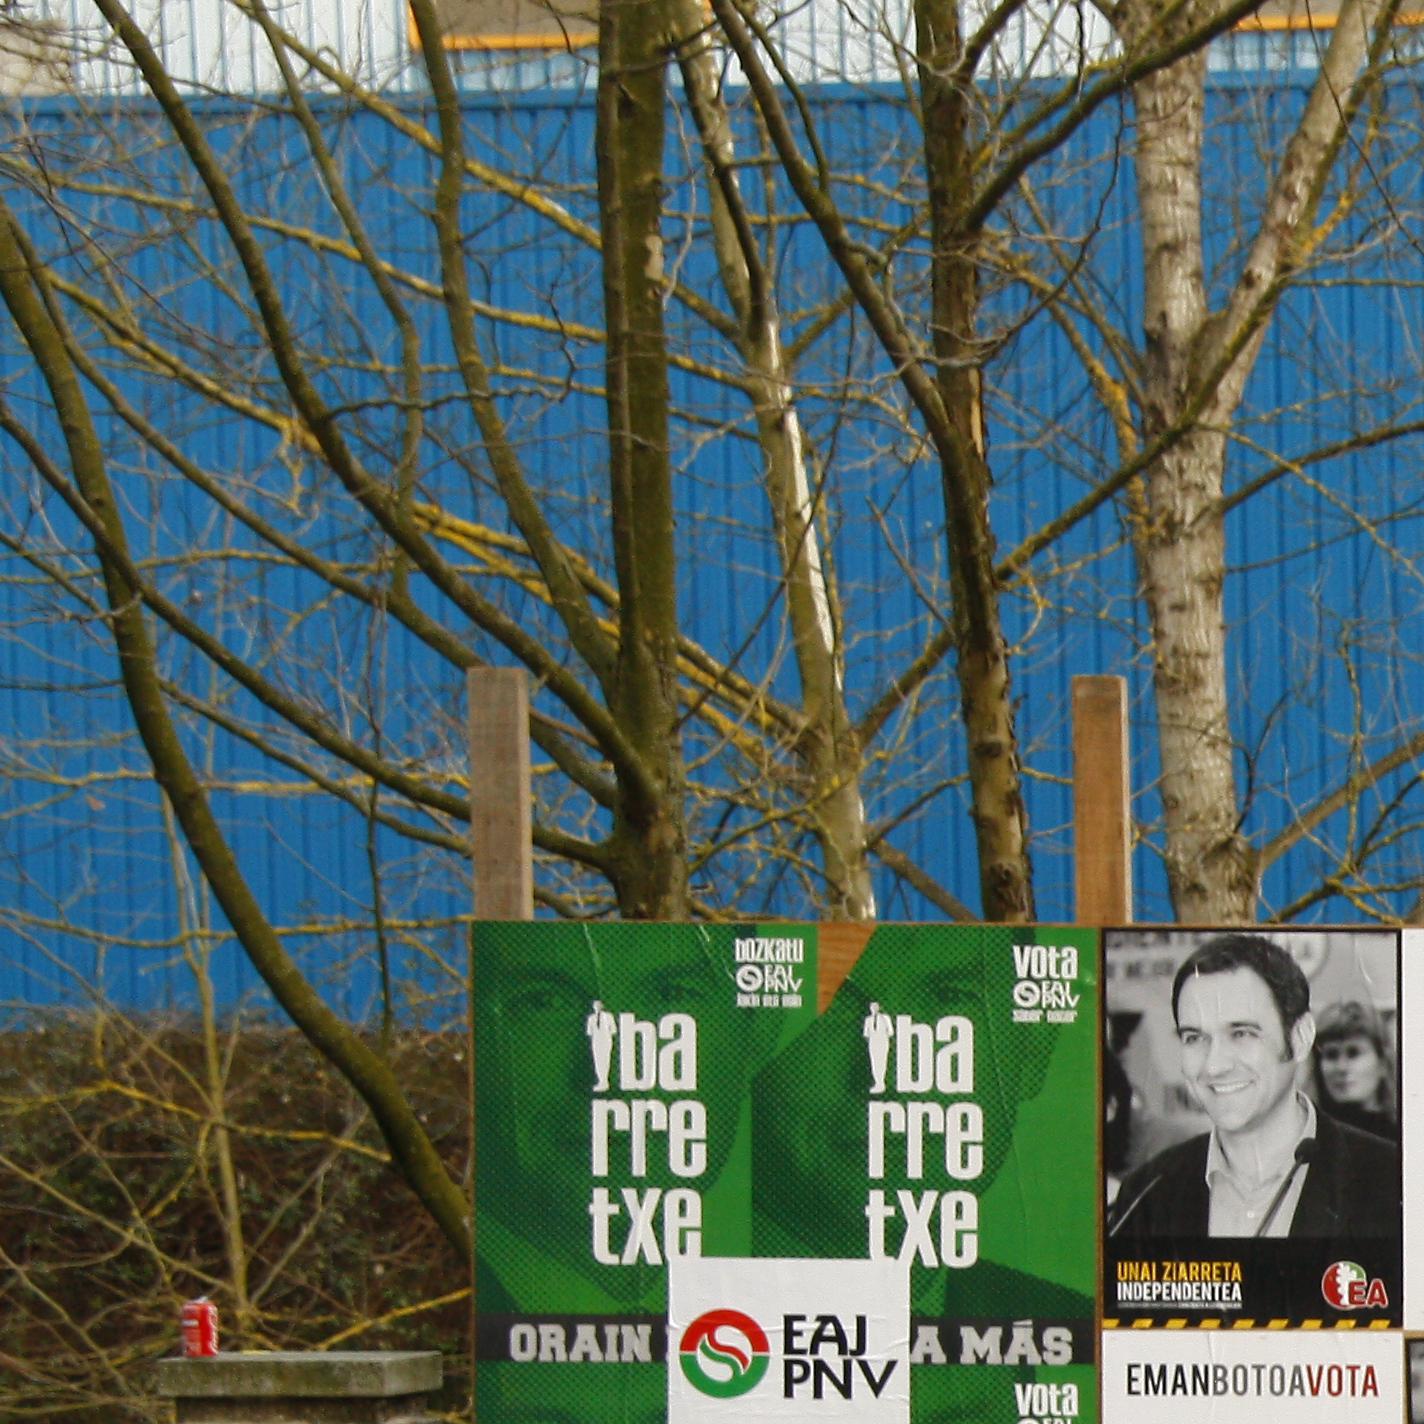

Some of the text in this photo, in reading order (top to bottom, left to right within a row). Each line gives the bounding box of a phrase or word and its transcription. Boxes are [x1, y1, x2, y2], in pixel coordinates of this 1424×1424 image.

[592, 1099, 707, 1177] rre
[869, 1100, 984, 1179] rre
[589, 1187, 703, 1266] txe
[865, 1189, 978, 1269] txe
[1117, 1261, 1243, 1282] UNAI ZIARRETA
[1117, 1282, 1243, 1301] INDEPENDENTEA
[1348, 1278, 1389, 1308] EA
[509, 1323, 653, 1364] ORAIN
[783, 1314, 869, 1357] EAJ
[959, 1318, 1075, 1366] MÁS
[783, 1360, 899, 1400] PNV
